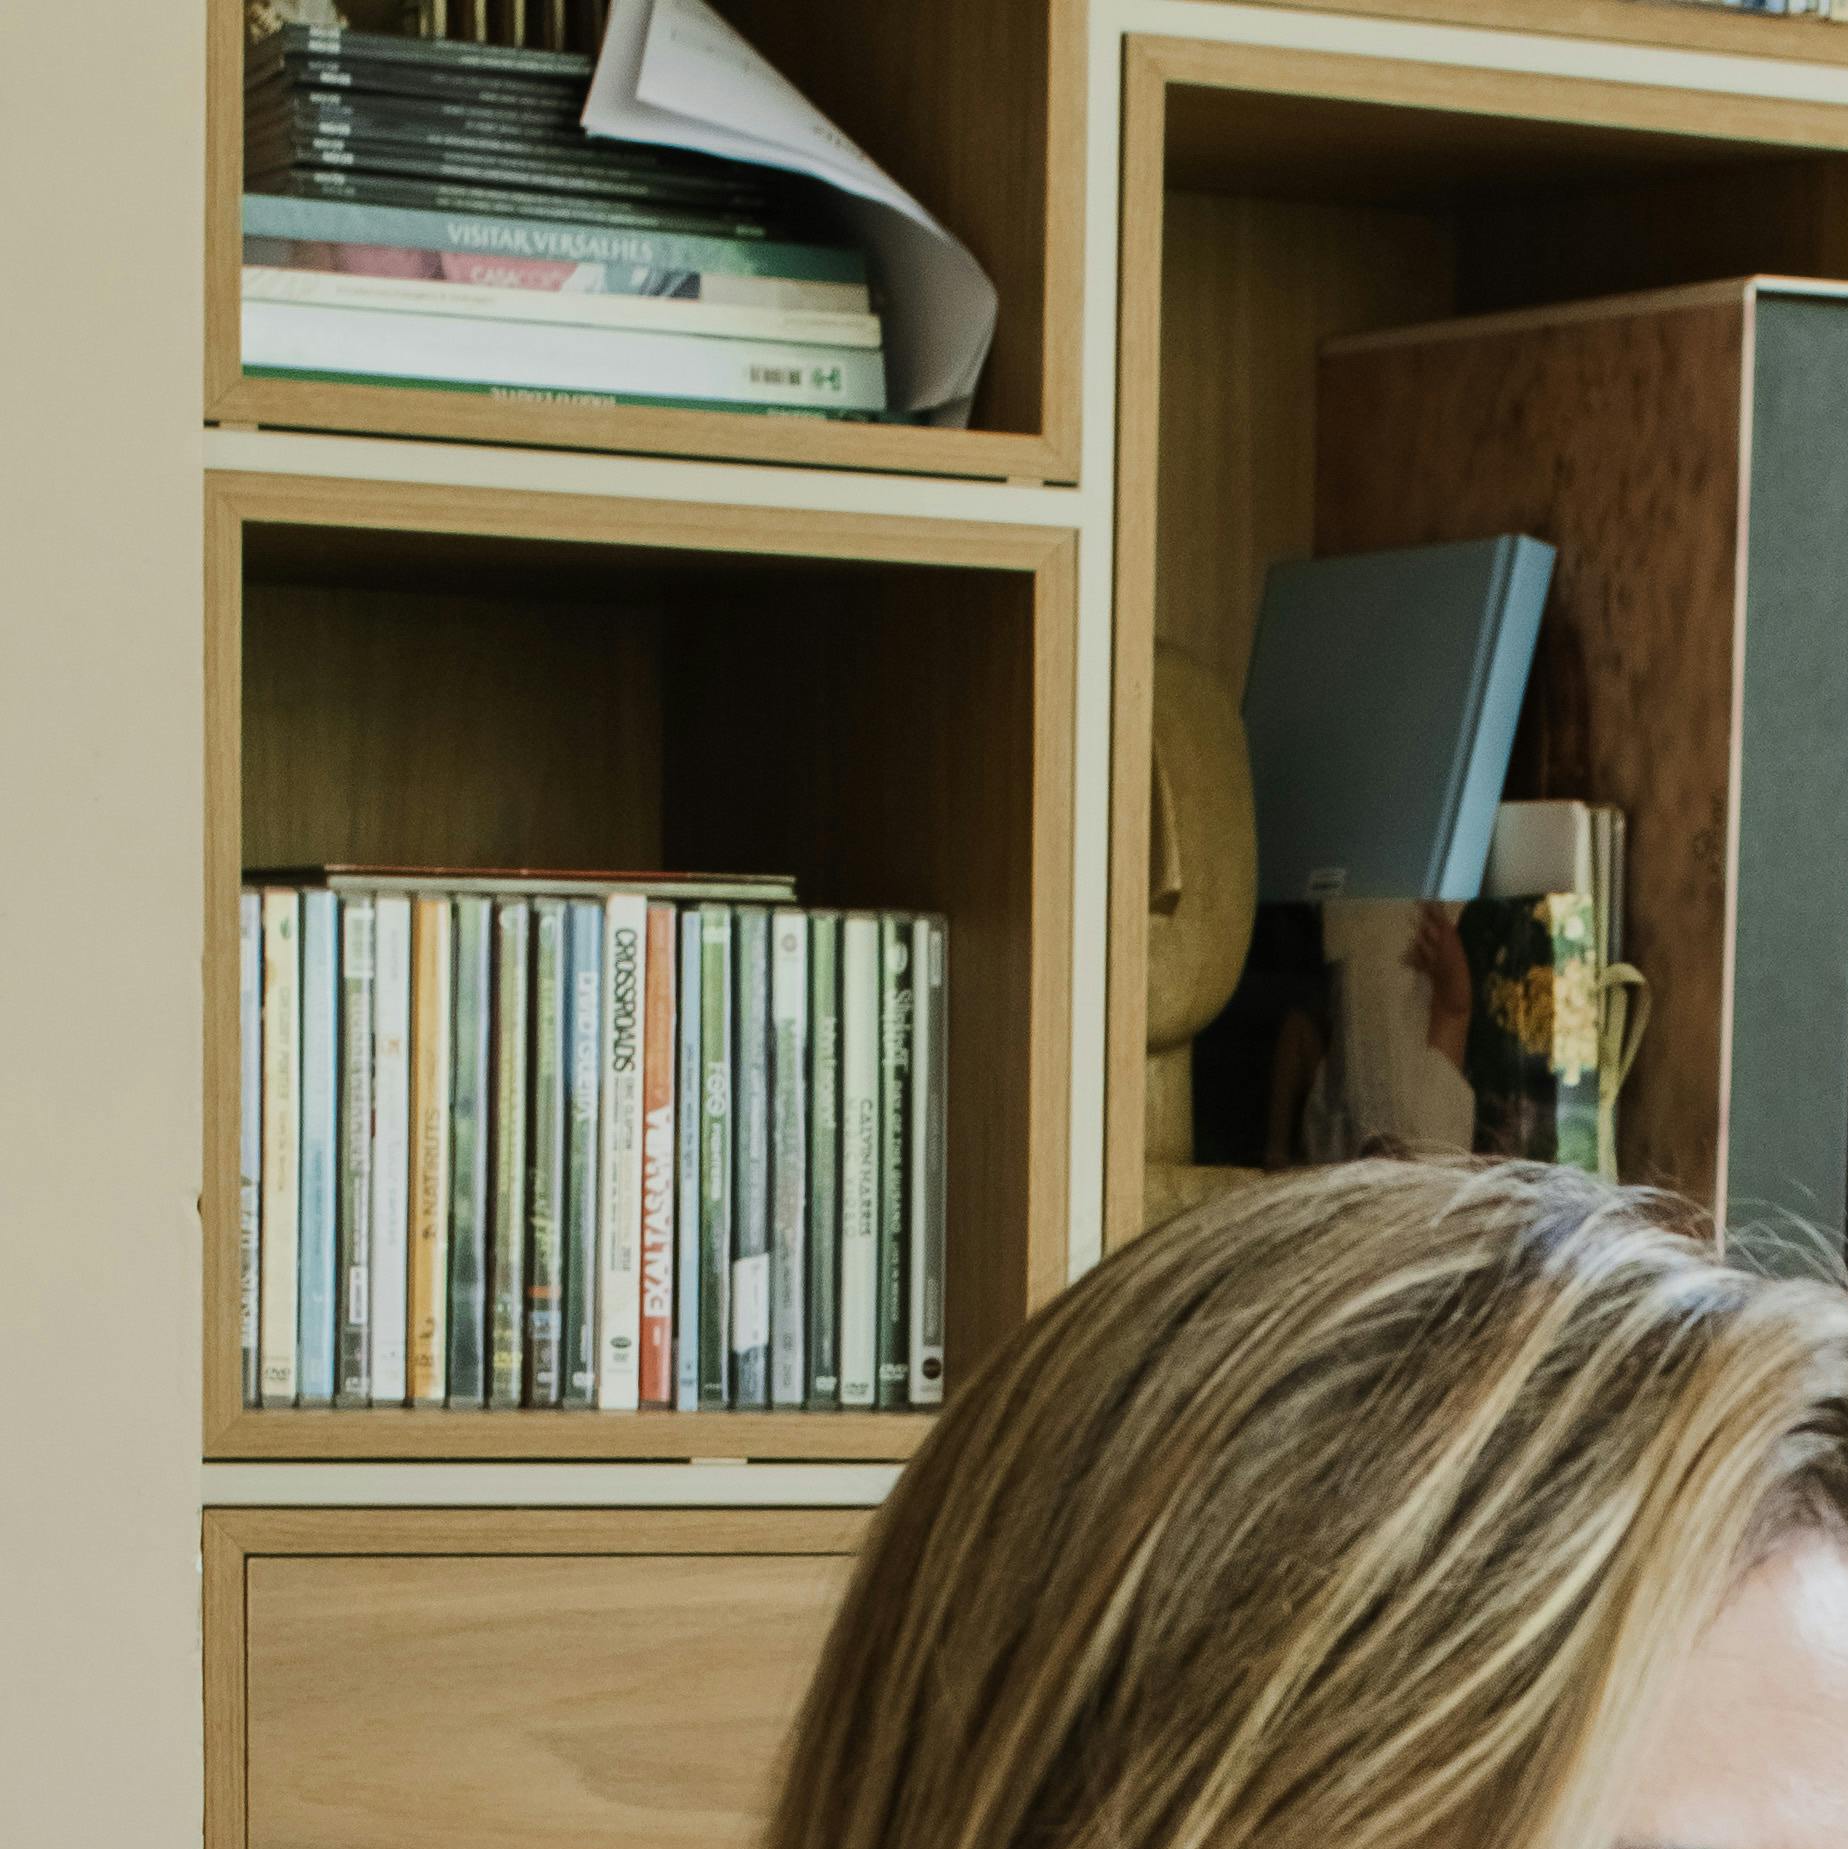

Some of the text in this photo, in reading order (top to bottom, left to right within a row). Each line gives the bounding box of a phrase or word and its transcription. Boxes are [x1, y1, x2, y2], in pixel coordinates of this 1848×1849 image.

[446, 222, 529, 253] VISITAR
[576, 970, 598, 1034] DAVID
[613, 928, 638, 1073] CROSSROADS
[859, 1098, 873, 1237] CALVIN HARRIS
